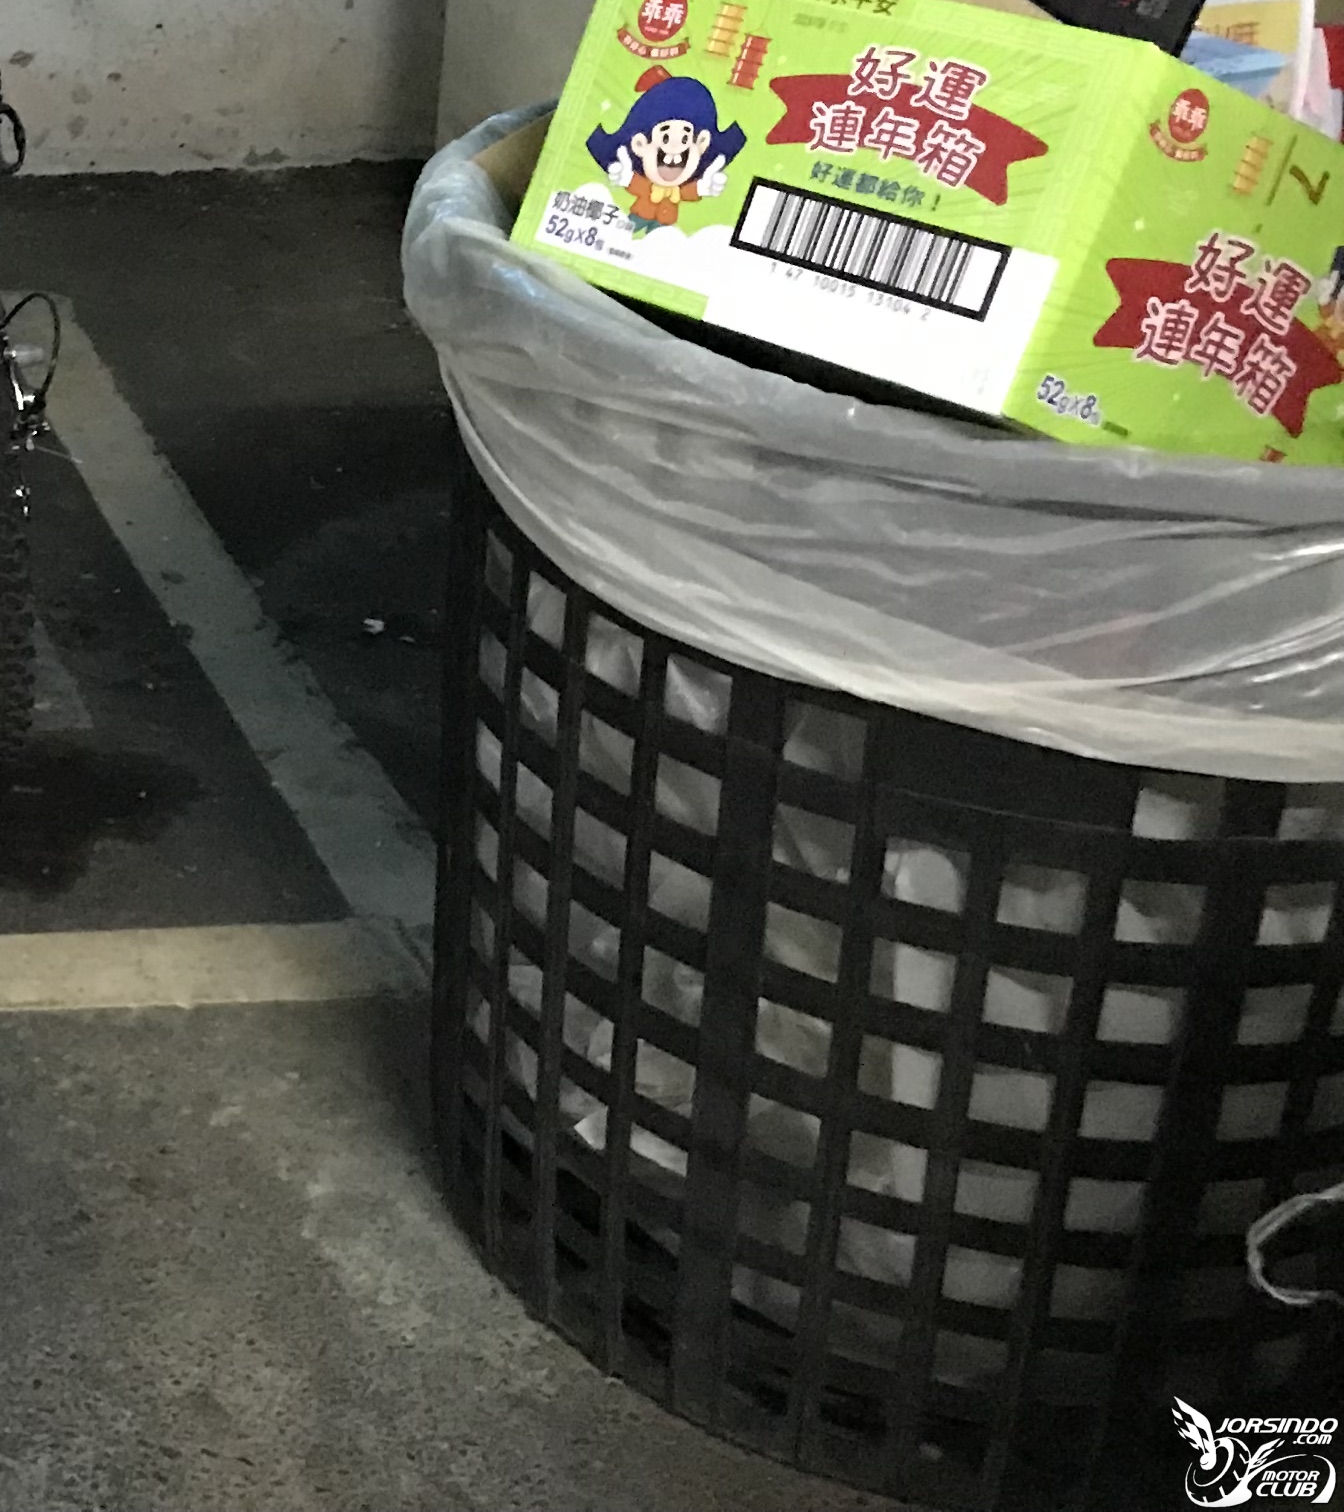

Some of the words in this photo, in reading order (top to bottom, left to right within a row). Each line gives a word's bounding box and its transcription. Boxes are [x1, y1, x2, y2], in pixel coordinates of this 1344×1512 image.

[848, 45, 988, 119] 好運
[809, 102, 986, 188] 連年箱
[920, 308, 931, 321] 2
[1186, 231, 1312, 334] 好運
[1134, 298, 1297, 415] 連年箱
